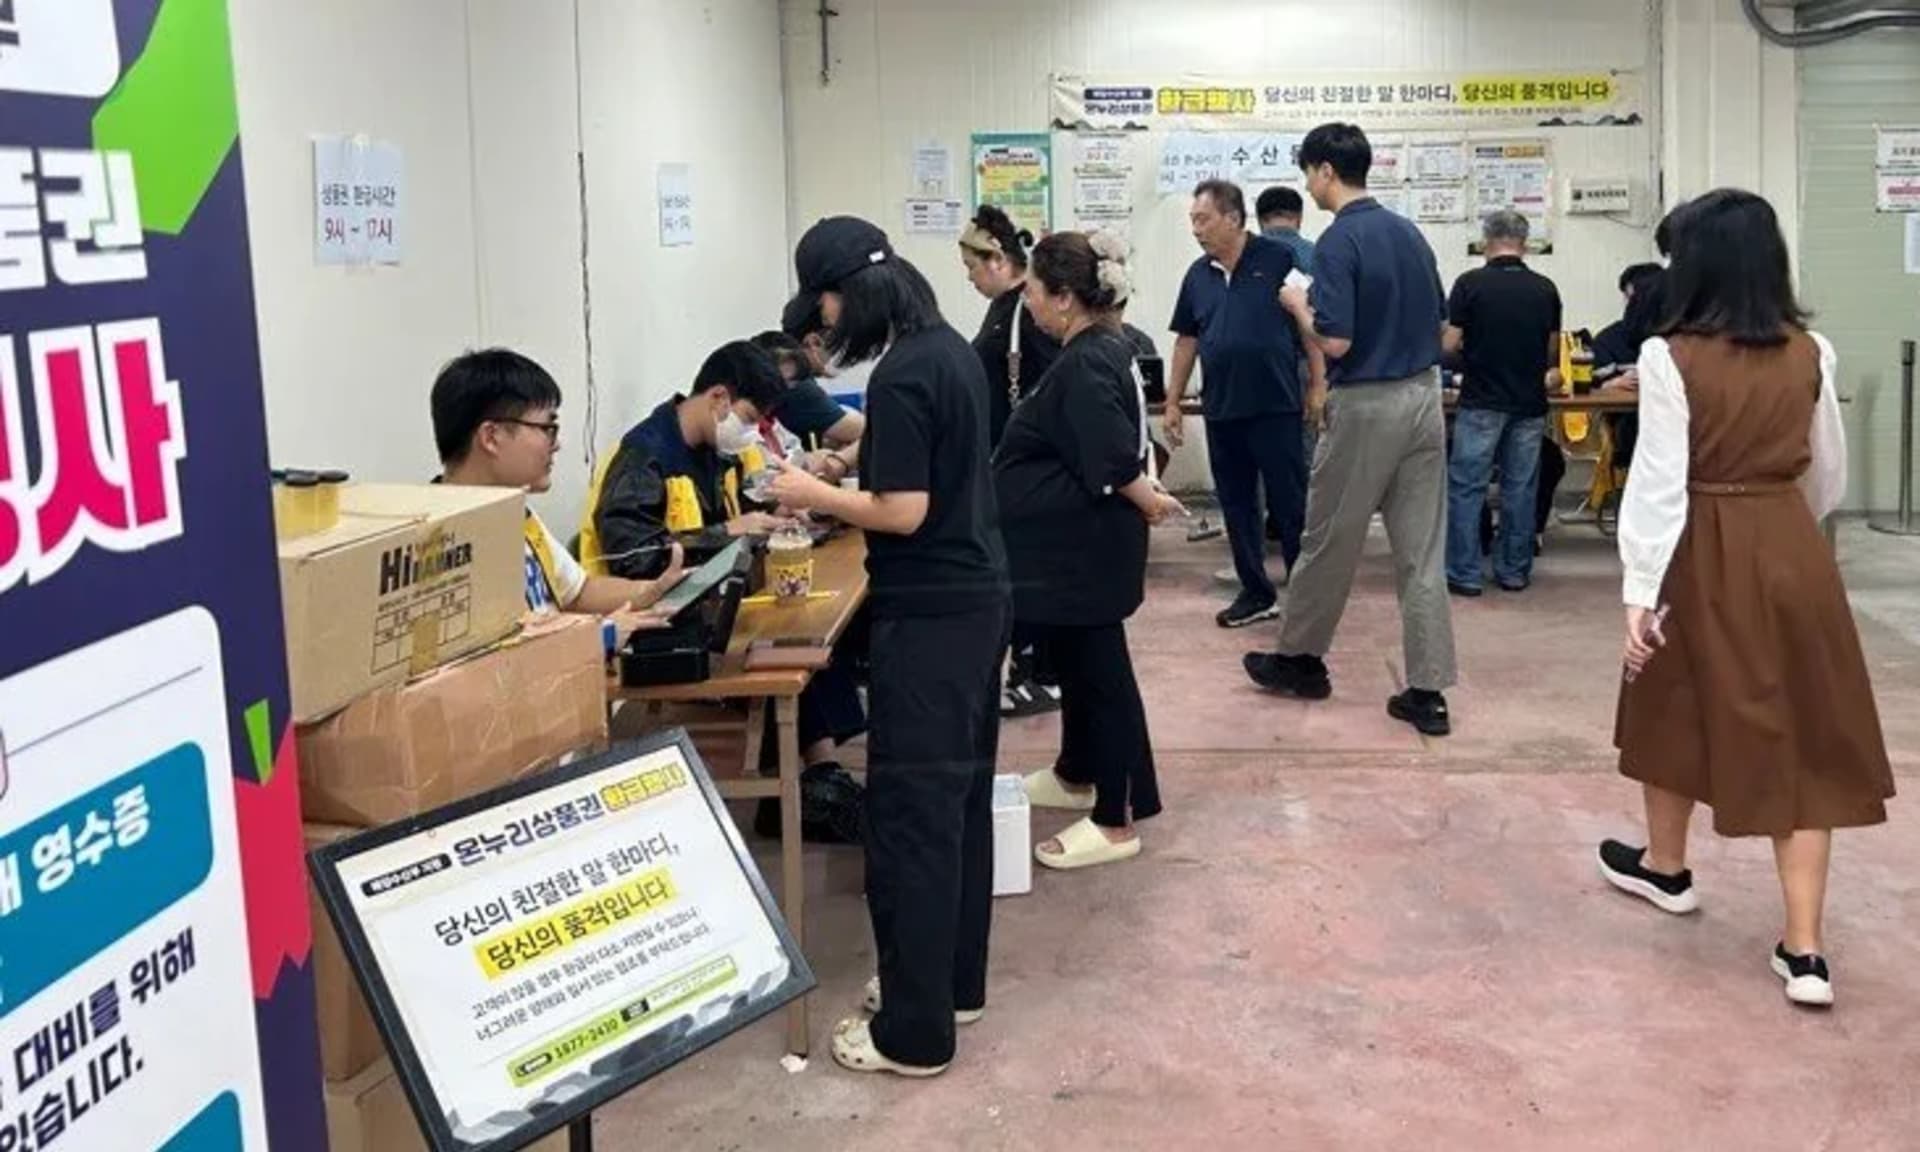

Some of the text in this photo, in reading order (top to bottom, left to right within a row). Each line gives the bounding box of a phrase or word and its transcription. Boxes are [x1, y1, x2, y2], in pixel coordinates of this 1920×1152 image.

[1264, 86, 1315, 103] 당신의
[1320, 85, 1373, 103] 친절한
[1399, 84, 1458, 103] 한마디,
[1462, 82, 1516, 101] 당신의
[1521, 80, 1610, 101] 품격입니다
[325, 217, 346, 245] 9시
[0, 318, 187, 595] 사
[379, 543, 412, 597] Hi
[32, 783, 150, 893] 영수증
[452, 793, 604, 867] 온누리상품권
[434, 832, 681, 948] 당신의 친절한 말 한마디,
[487, 877, 670, 971] 당신의 품격입니다
[13, 926, 196, 1094] 대비를 위해
